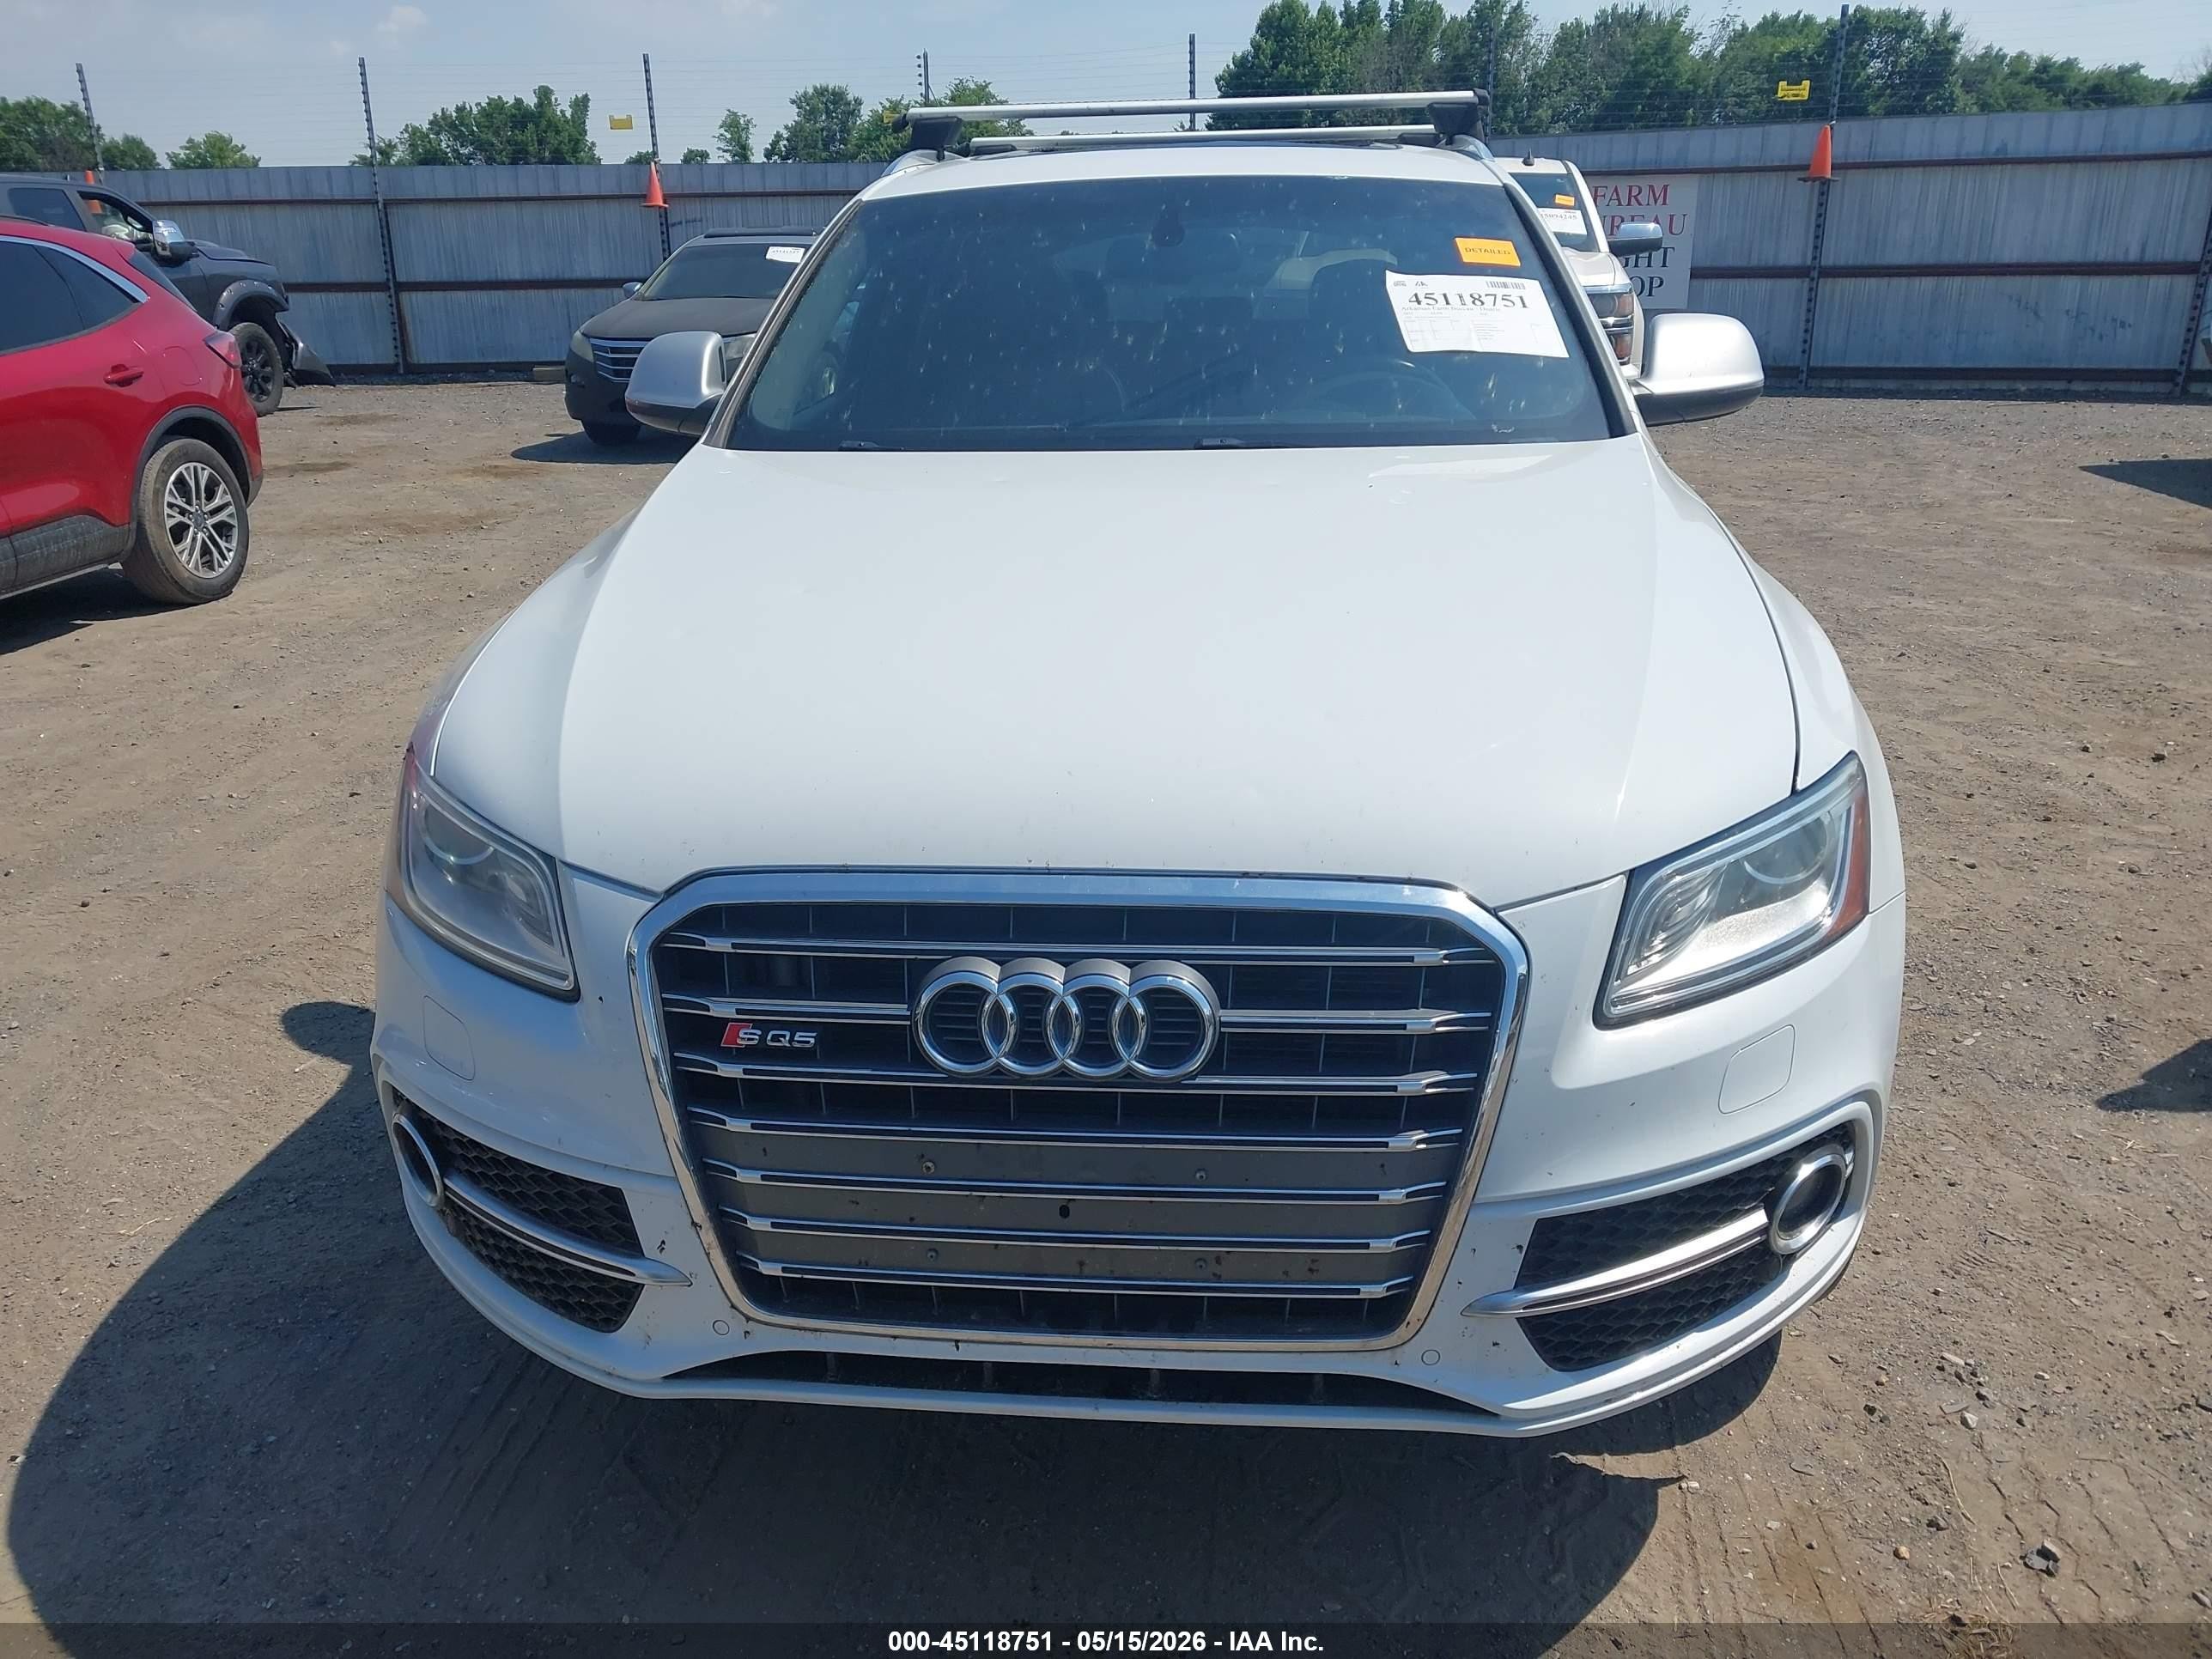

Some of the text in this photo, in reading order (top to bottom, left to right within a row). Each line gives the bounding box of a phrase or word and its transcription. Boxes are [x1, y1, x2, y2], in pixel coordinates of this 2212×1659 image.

[1593, 184, 1670, 207] FARM
[1464, 246, 1511, 255] DETAILED
[1408, 292, 1530, 309] 45118751
